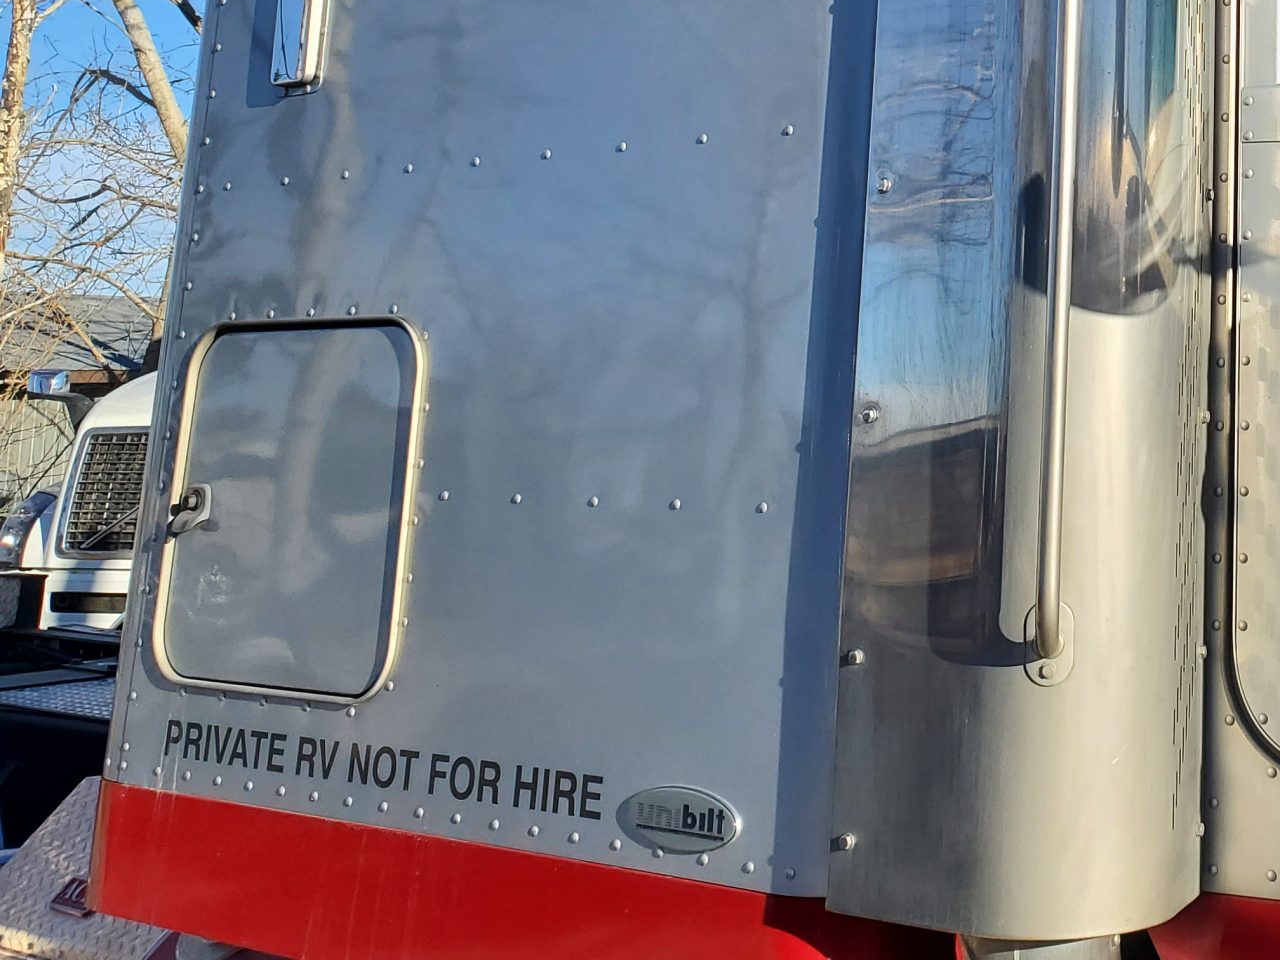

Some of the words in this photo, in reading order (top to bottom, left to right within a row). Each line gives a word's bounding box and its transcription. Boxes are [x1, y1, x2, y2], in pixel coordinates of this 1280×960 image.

[164, 720, 288, 773] PRIVATE
[295, 736, 340, 780] RV
[347, 742, 420, 792] NOT
[427, 753, 501, 805] FOR
[512, 765, 604, 821] HIRE
[637, 803, 726, 836] unibilt
